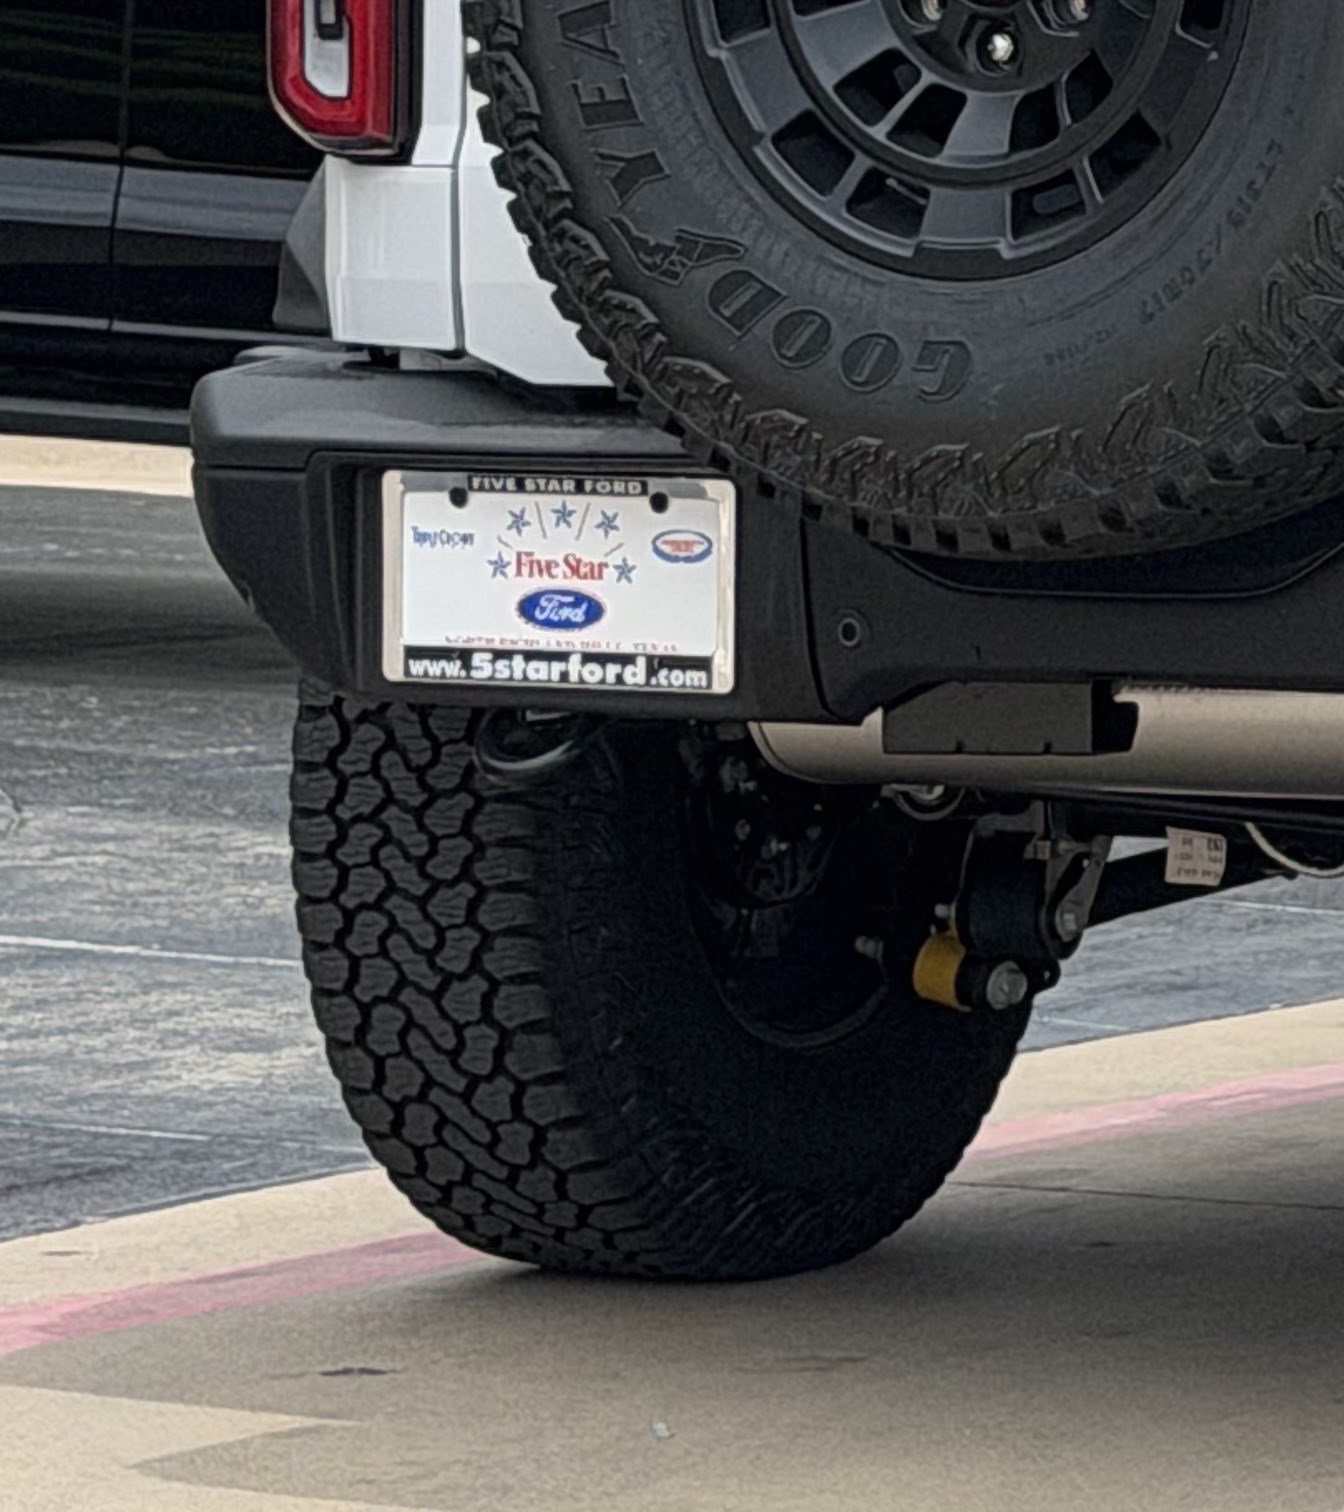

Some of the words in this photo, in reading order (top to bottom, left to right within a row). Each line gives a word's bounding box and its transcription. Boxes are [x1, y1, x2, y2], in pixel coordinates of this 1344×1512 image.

[471, 476, 517, 492] FIVE
[524, 477, 577, 495] STAR
[584, 479, 644, 496] FORD
[514, 551, 560, 580] Five
[562, 552, 610, 581] Star
[533, 593, 587, 624] Ford
[407, 651, 709, 688] www.5starford.com
